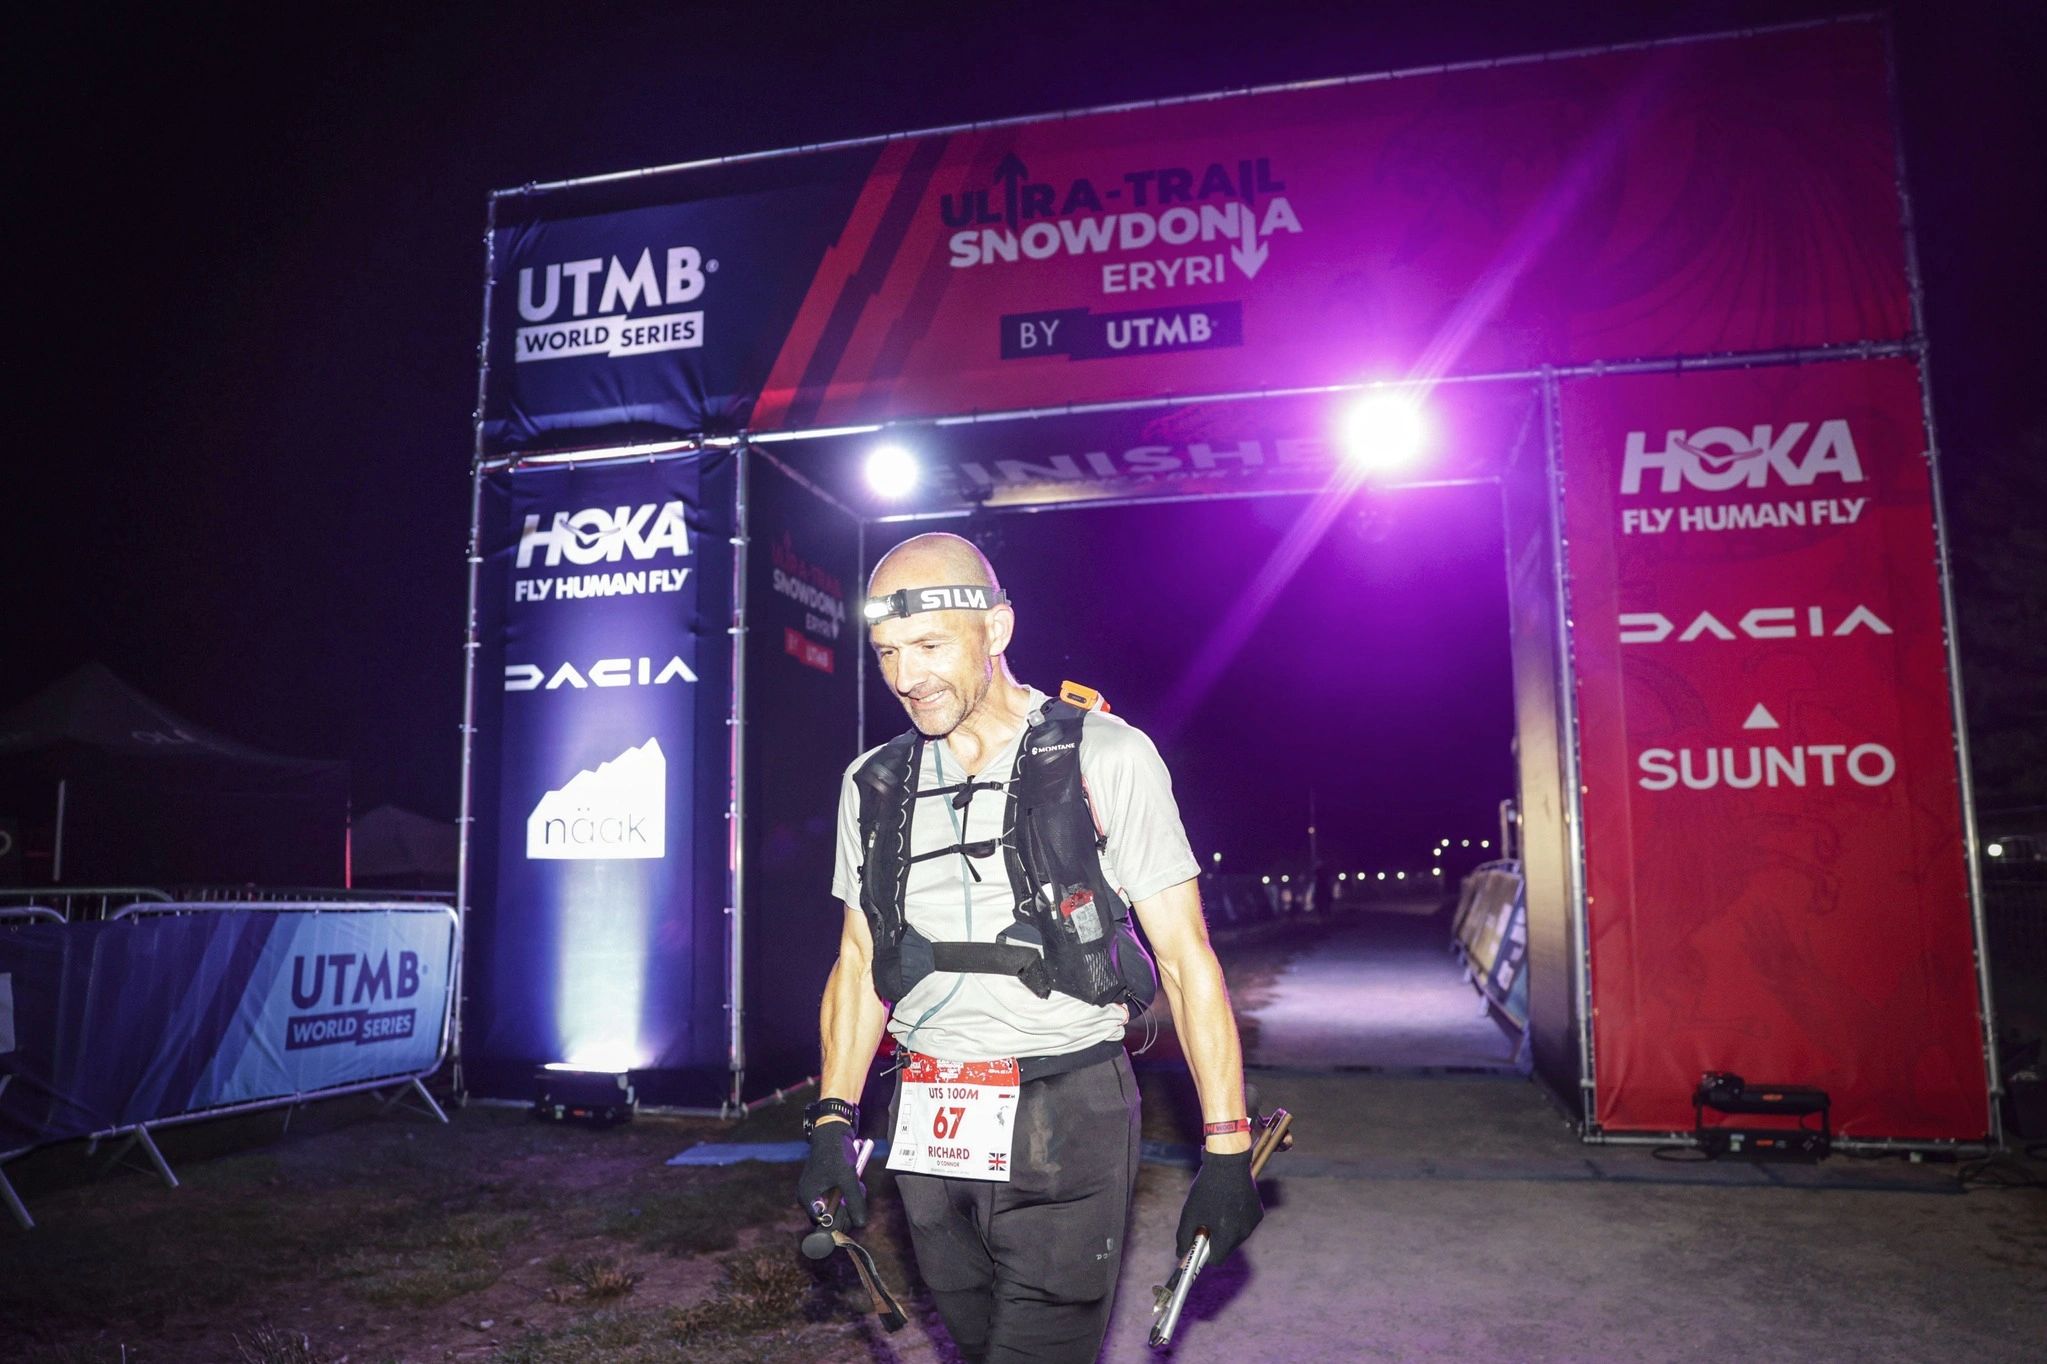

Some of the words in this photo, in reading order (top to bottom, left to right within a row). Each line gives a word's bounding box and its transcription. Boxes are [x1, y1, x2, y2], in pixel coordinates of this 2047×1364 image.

[949, 196, 1303, 270] SNOWDONIA
[1102, 254, 1225, 293] ERYRI
[525, 326, 609, 353] WORLD
[620, 320, 696, 347] SERIES
[1019, 319, 1059, 349] BY
[1620, 419, 1863, 494] HOKA
[516, 500, 690, 568] HOKA
[1622, 507, 1673, 534] FLY
[1679, 501, 1806, 532] HUMAN
[1810, 498, 1866, 526] FLY
[515, 578, 553, 602] FLY
[555, 571, 646, 600] HUMAN
[648, 567, 691, 593] FLY
[1618, 604, 1894, 643] DACIA
[504, 655, 699, 692] DACIA
[1038, 743, 1076, 753] MONTANE
[1638, 743, 1896, 790] SUUNTO
[545, 807, 647, 845] näak
[293, 1016, 358, 1043] WORLD
[361, 1014, 412, 1039] SERIES
[928, 1087, 944, 1100] UTS
[947, 1087, 979, 1101] 100M
[932, 1106, 966, 1140] 67
[927, 1145, 970, 1160] RICHARD
